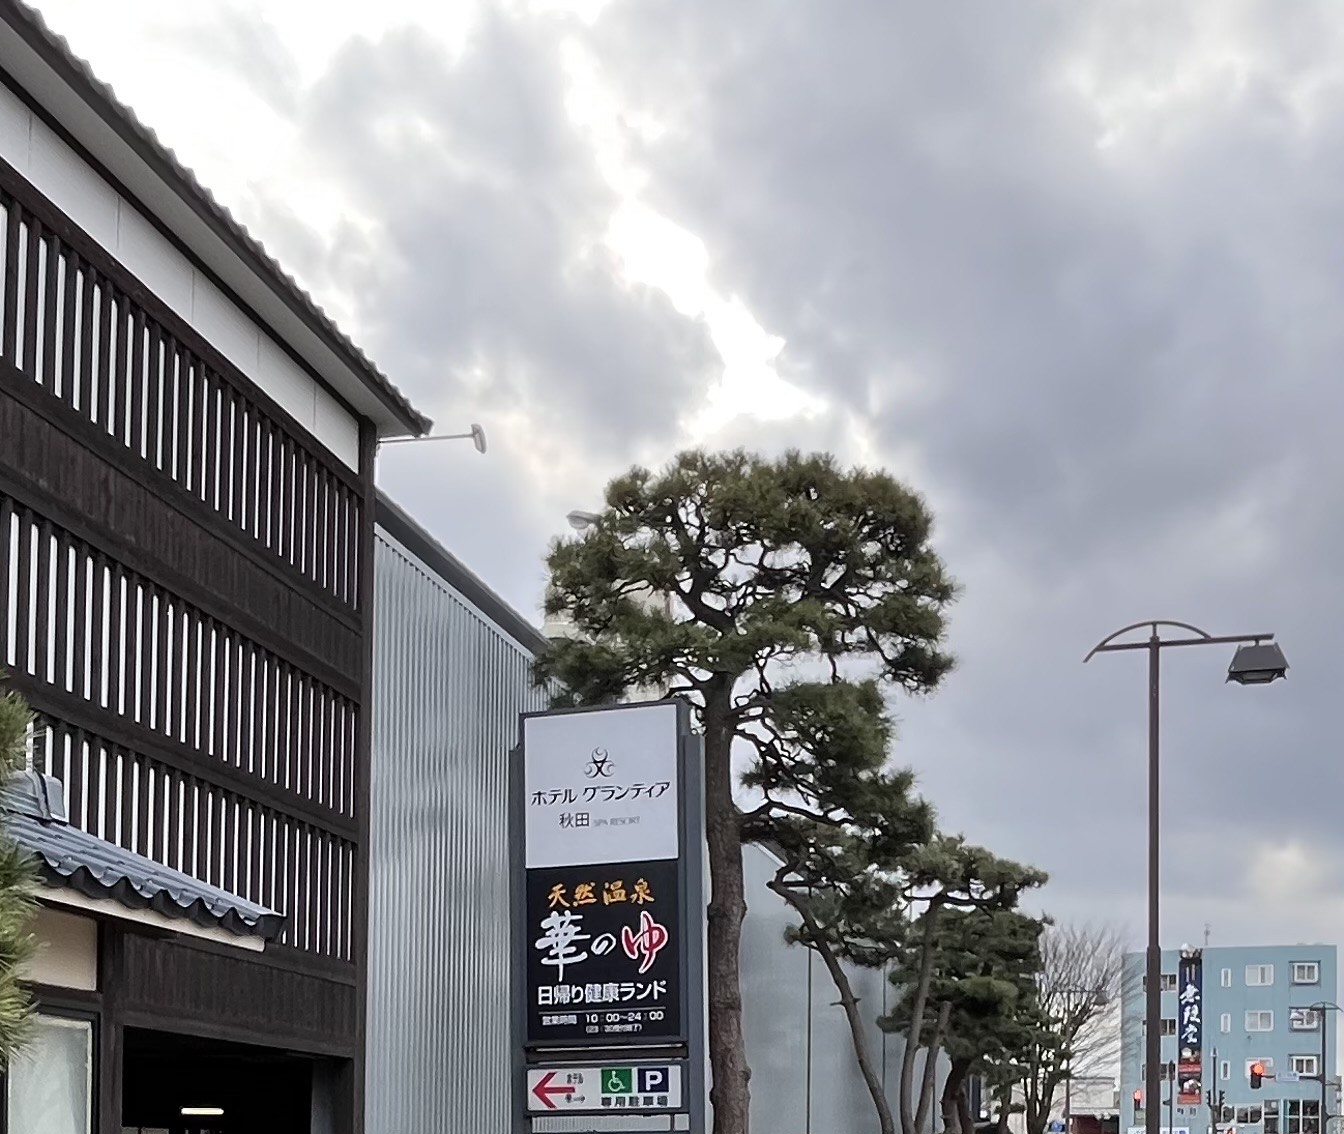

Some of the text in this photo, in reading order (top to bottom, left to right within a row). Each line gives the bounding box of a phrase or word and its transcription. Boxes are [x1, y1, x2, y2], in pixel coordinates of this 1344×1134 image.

[531, 781, 671, 806] ホテル グランティア
[559, 812, 590, 829] 秋田
[548, 878, 655, 908] 天然温泉
[535, 910, 668, 982] 華のゆ
[537, 980, 667, 1005] 日帰り健康ランド
[645, 1070, 663, 1091] P
